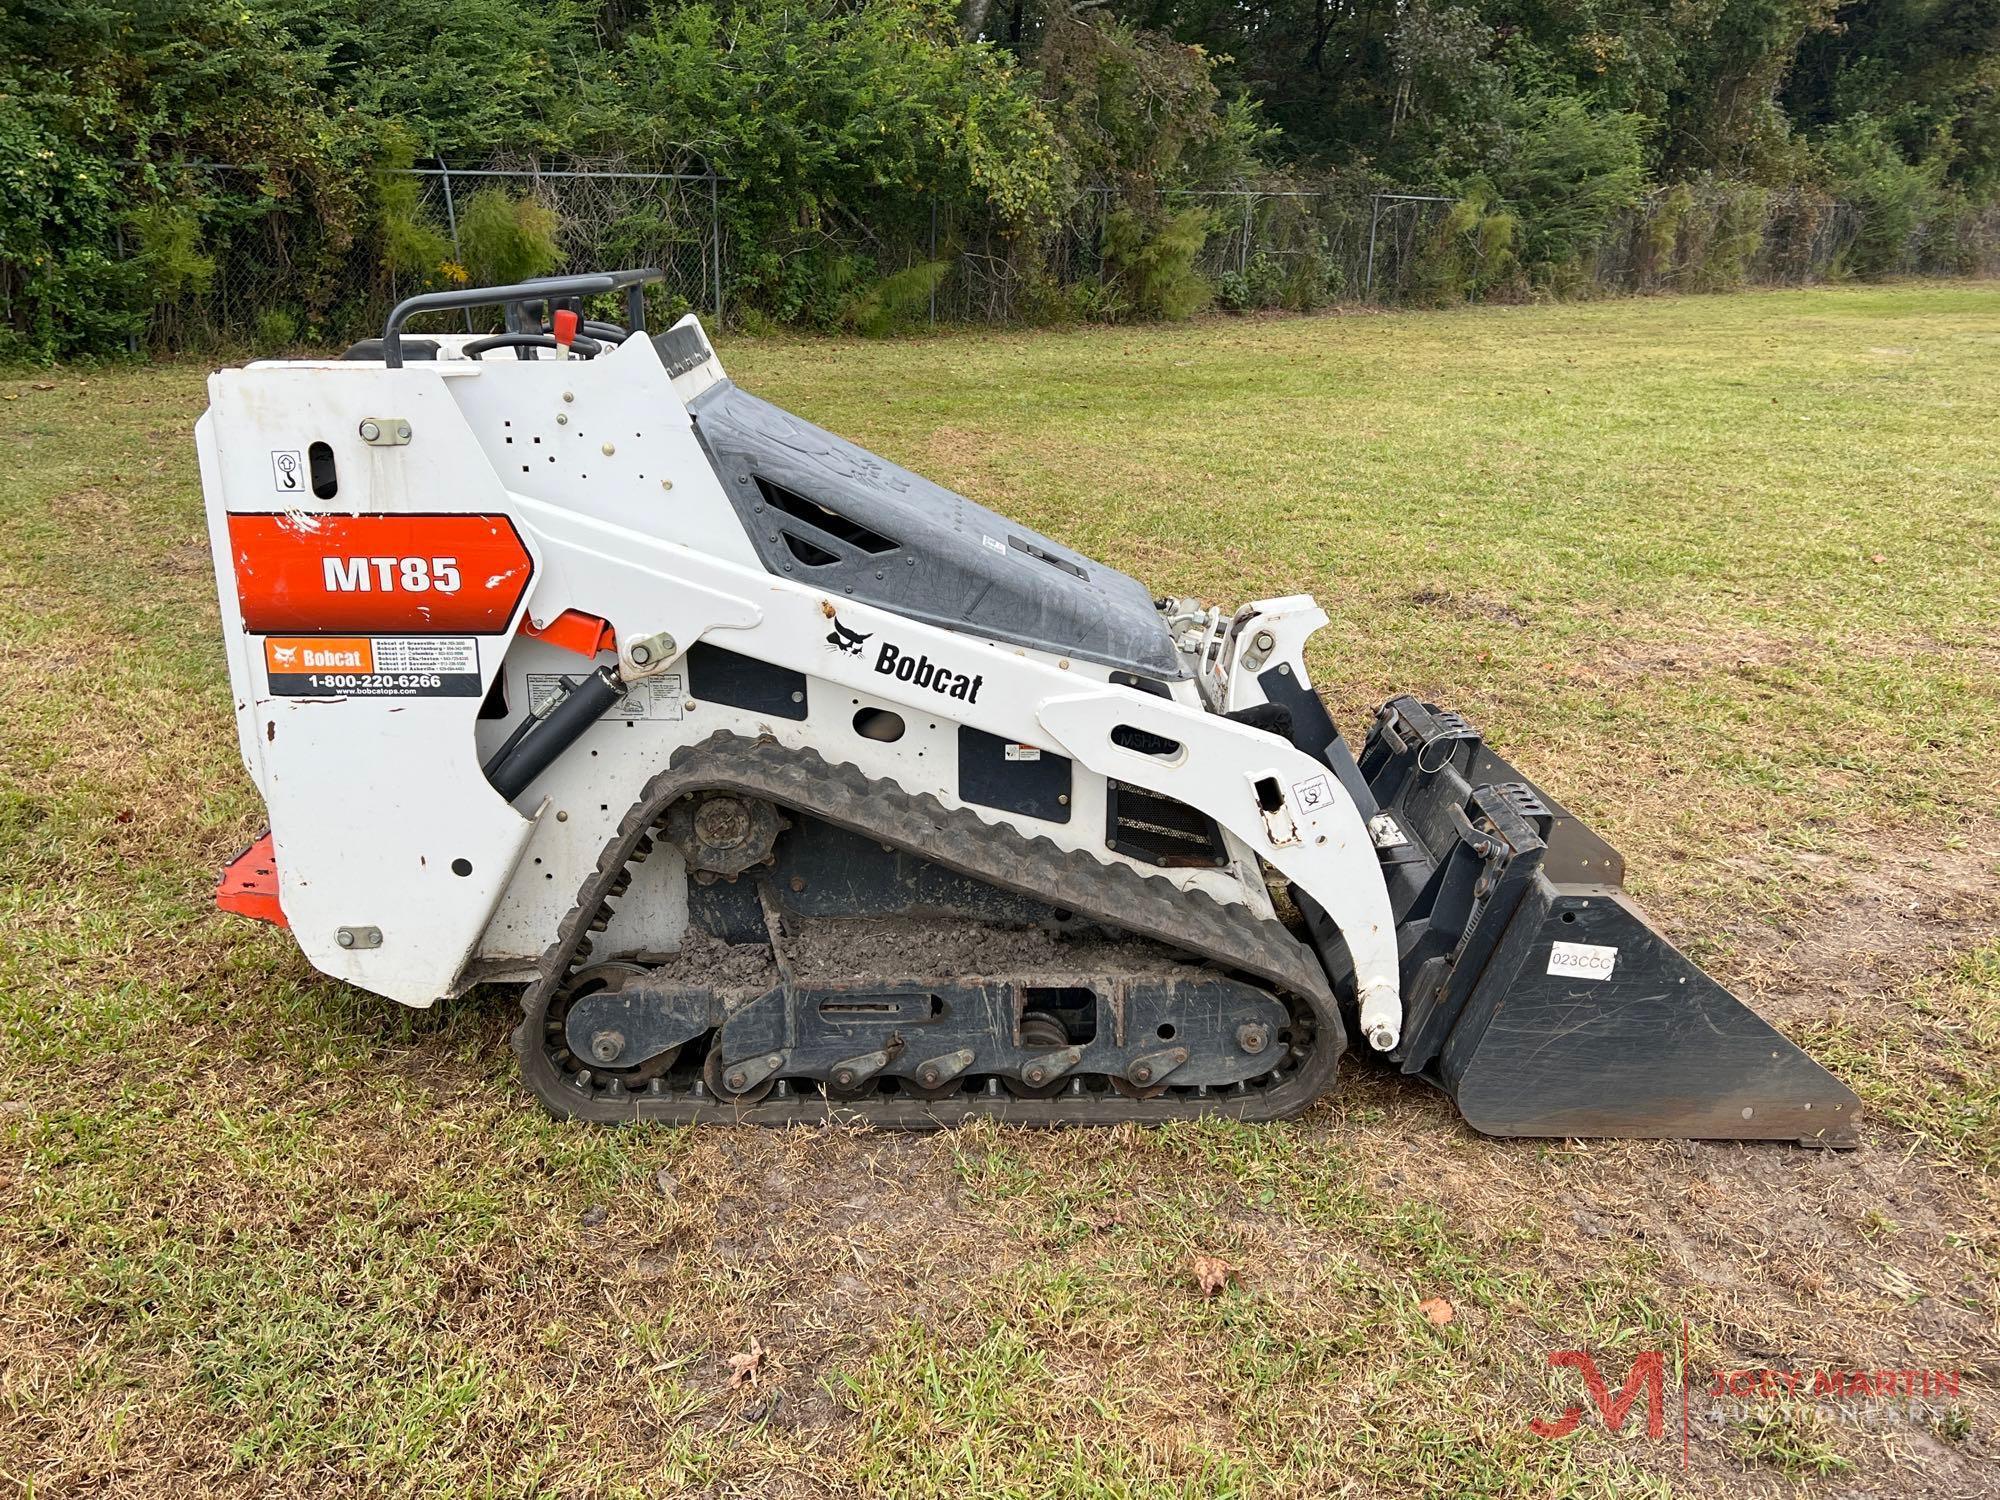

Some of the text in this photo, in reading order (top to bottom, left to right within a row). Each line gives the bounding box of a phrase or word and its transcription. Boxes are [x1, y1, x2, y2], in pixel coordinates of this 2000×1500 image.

[322, 557, 462, 592] MT85
[303, 649, 361, 667] Bobcat
[309, 675, 441, 688] 1-800-220-6266
[874, 642, 983, 705] Bobcat
[1553, 953, 1611, 969] 023CCC
